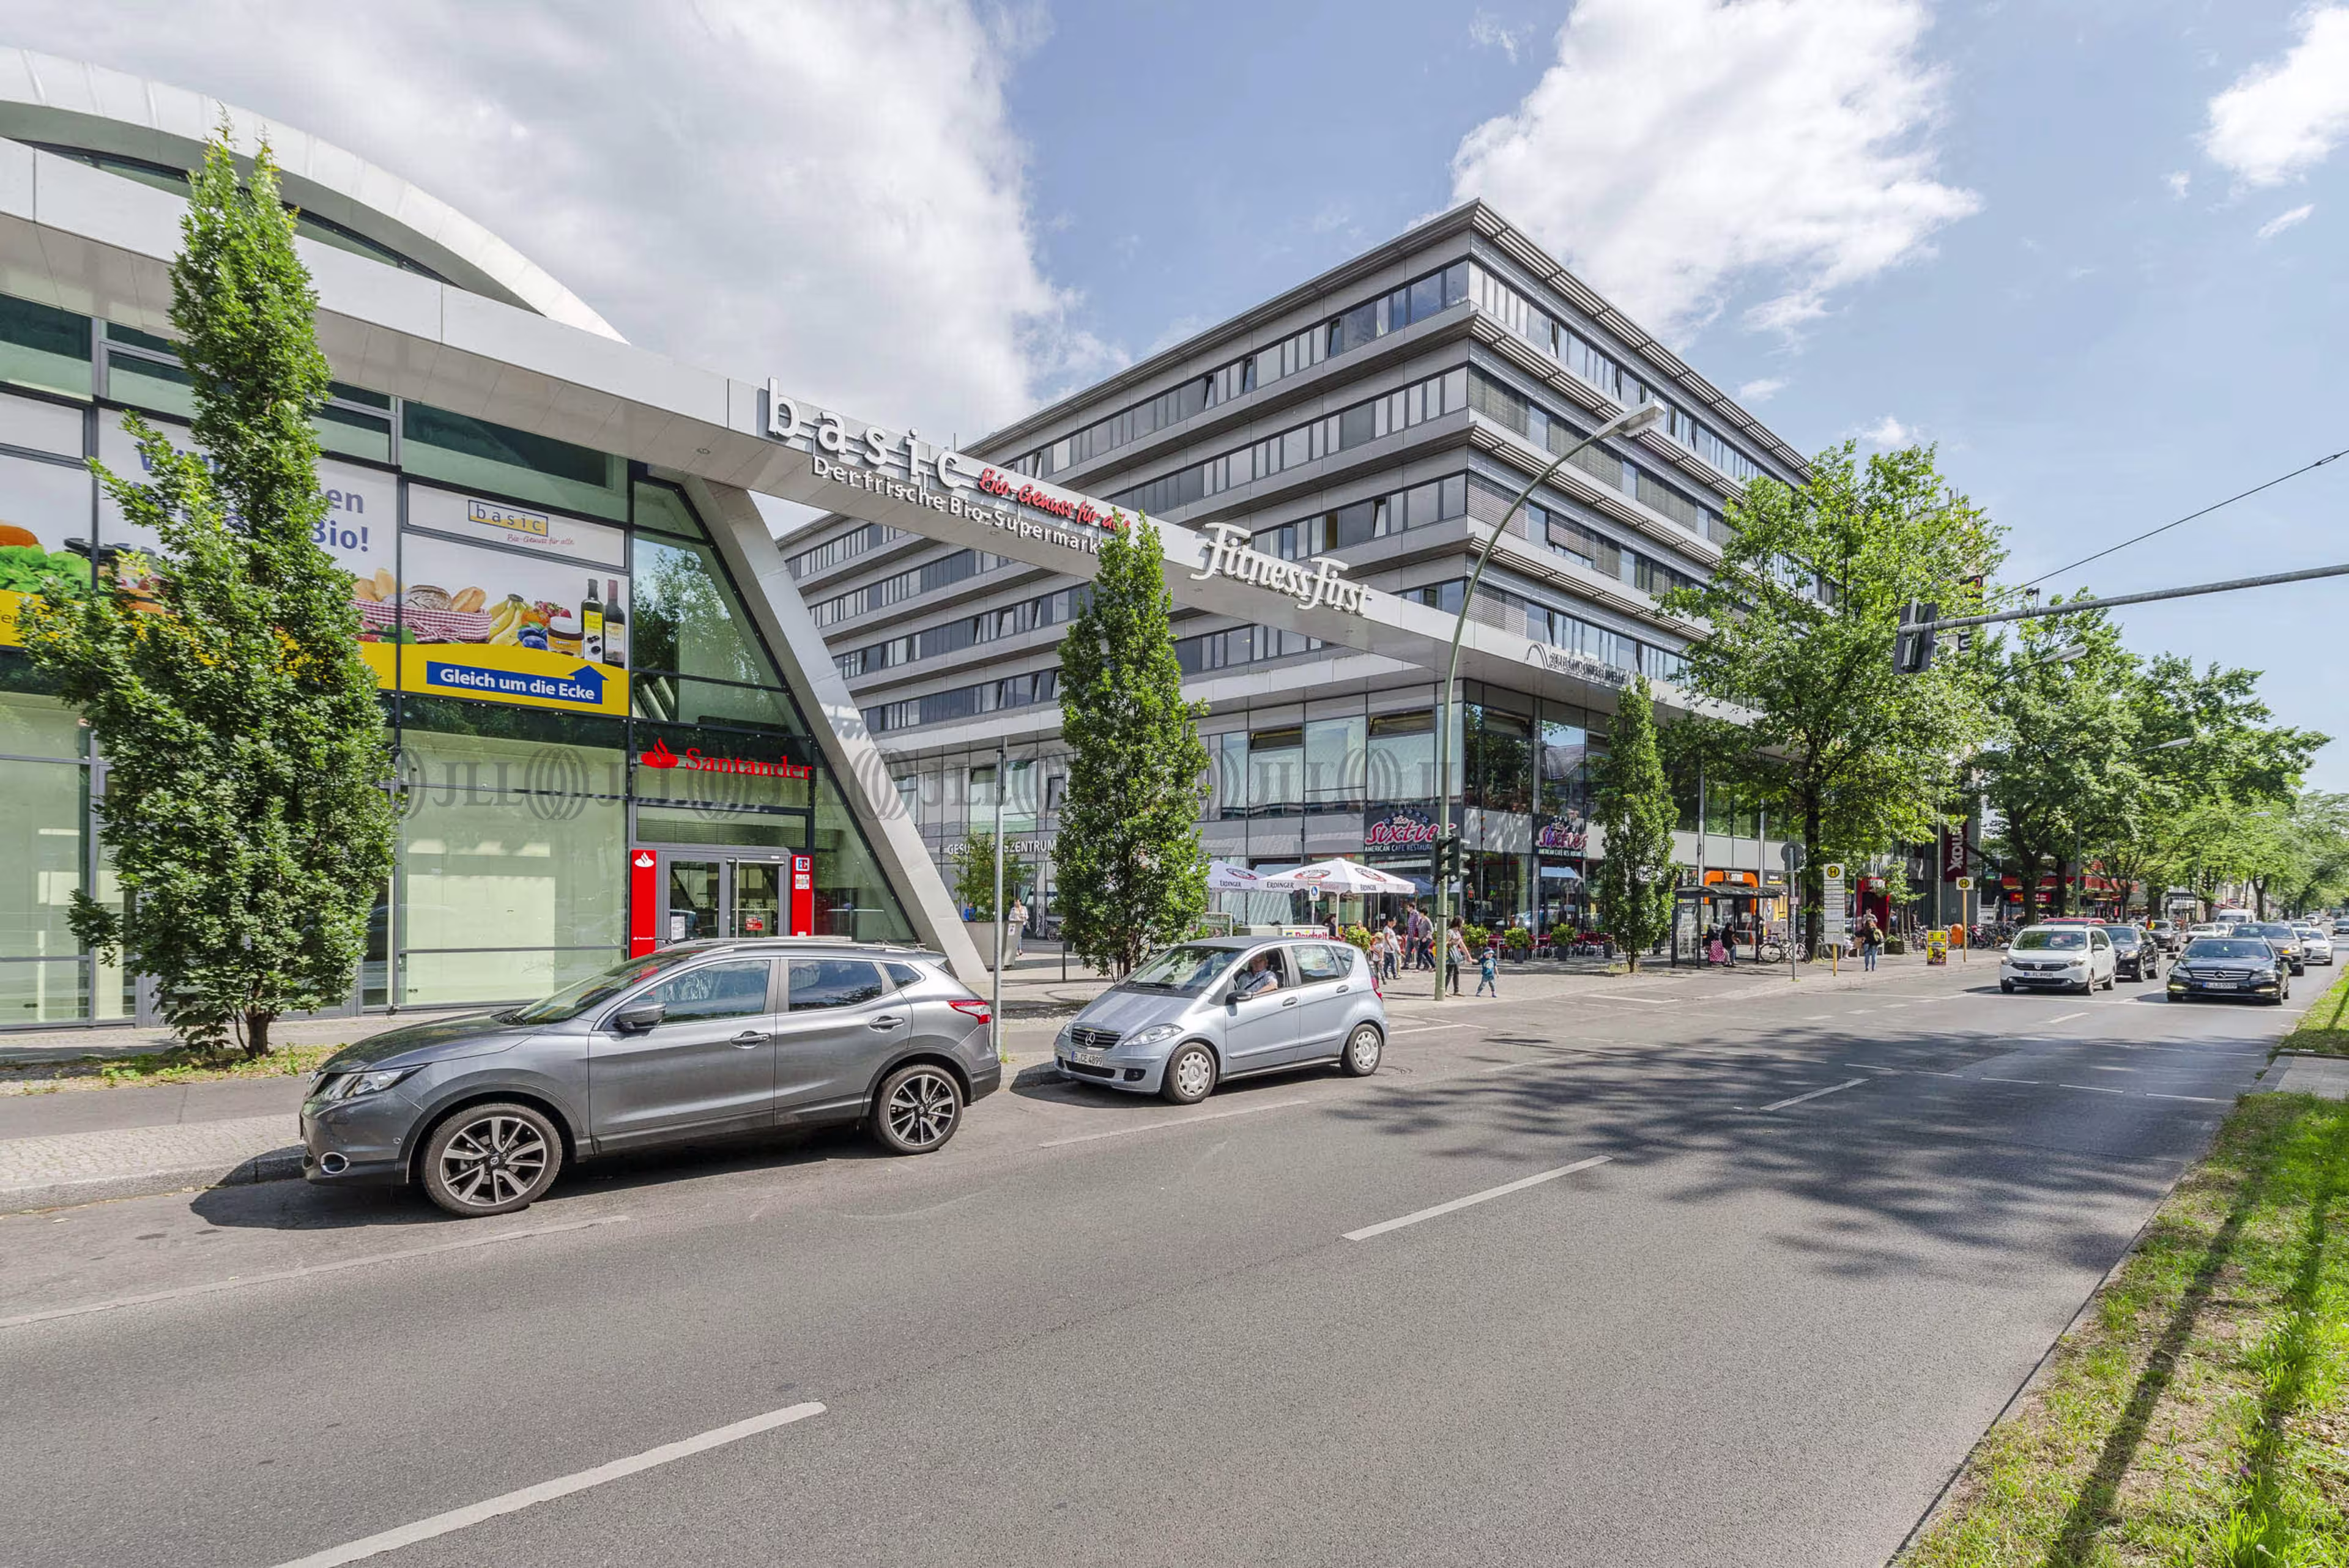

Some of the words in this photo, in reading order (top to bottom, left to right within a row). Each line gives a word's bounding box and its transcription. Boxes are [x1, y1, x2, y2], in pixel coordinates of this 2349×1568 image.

[768, 377, 961, 488] basic
[814, 456, 859, 487] Der
[861, 469, 946, 512] frische
[950, 497, 1105, 555] Bio-Supermark
[979, 467, 1075, 517] Bio-Genuss
[1075, 500, 1100, 524] für
[476, 504, 541, 531] basic
[440, 668, 495, 688] Gleich
[499, 678, 527, 692] um
[530, 679, 556, 695] die
[558, 683, 596, 700] Ecke
[686, 747, 813, 780] Santander
[1365, 821, 1457, 845] Sixtie
[1080, 1054, 1088, 1063] CE
[1089, 1056, 1102, 1066] 4899
